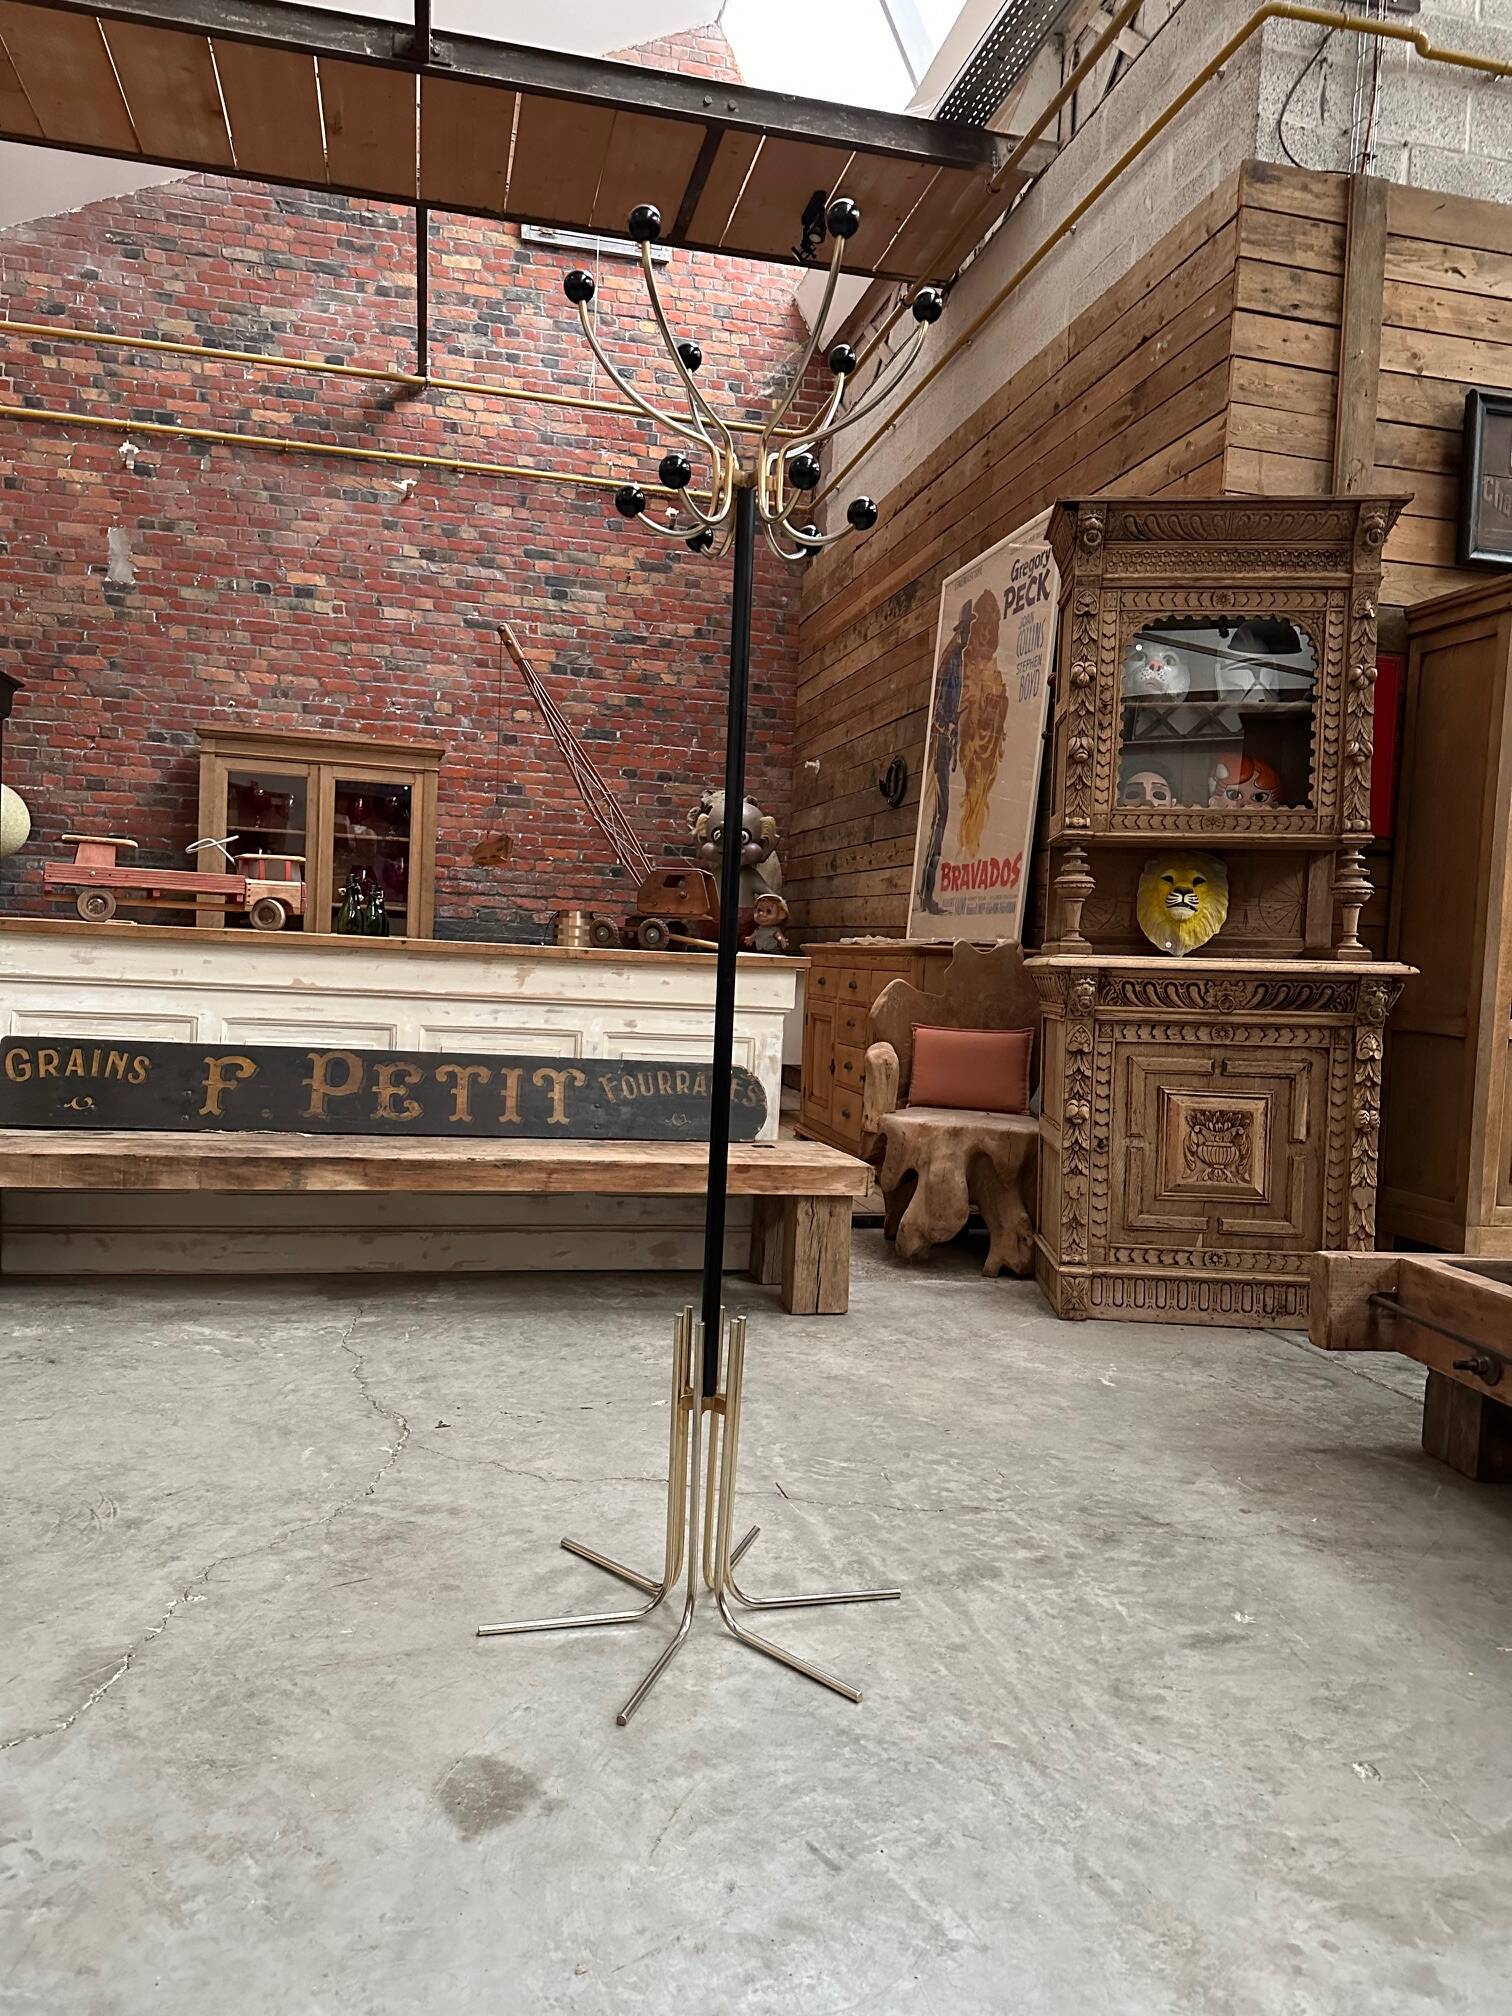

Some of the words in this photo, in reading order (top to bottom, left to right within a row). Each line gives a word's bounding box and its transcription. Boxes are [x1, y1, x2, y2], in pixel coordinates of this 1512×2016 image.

[1010, 548, 1051, 583] Gregory
[1003, 568, 1050, 620] PECK
[1016, 617, 1045, 658] COLLINS
[1016, 653, 1042, 675] STEPHEN
[1018, 669, 1040, 703] BOYD
[940, 851, 1022, 892] BRAVADOS
[5, 1048, 152, 1085] GRAINS
[301, 1050, 588, 1125] PETIT
[598, 1069, 760, 1108] FOURRAES
